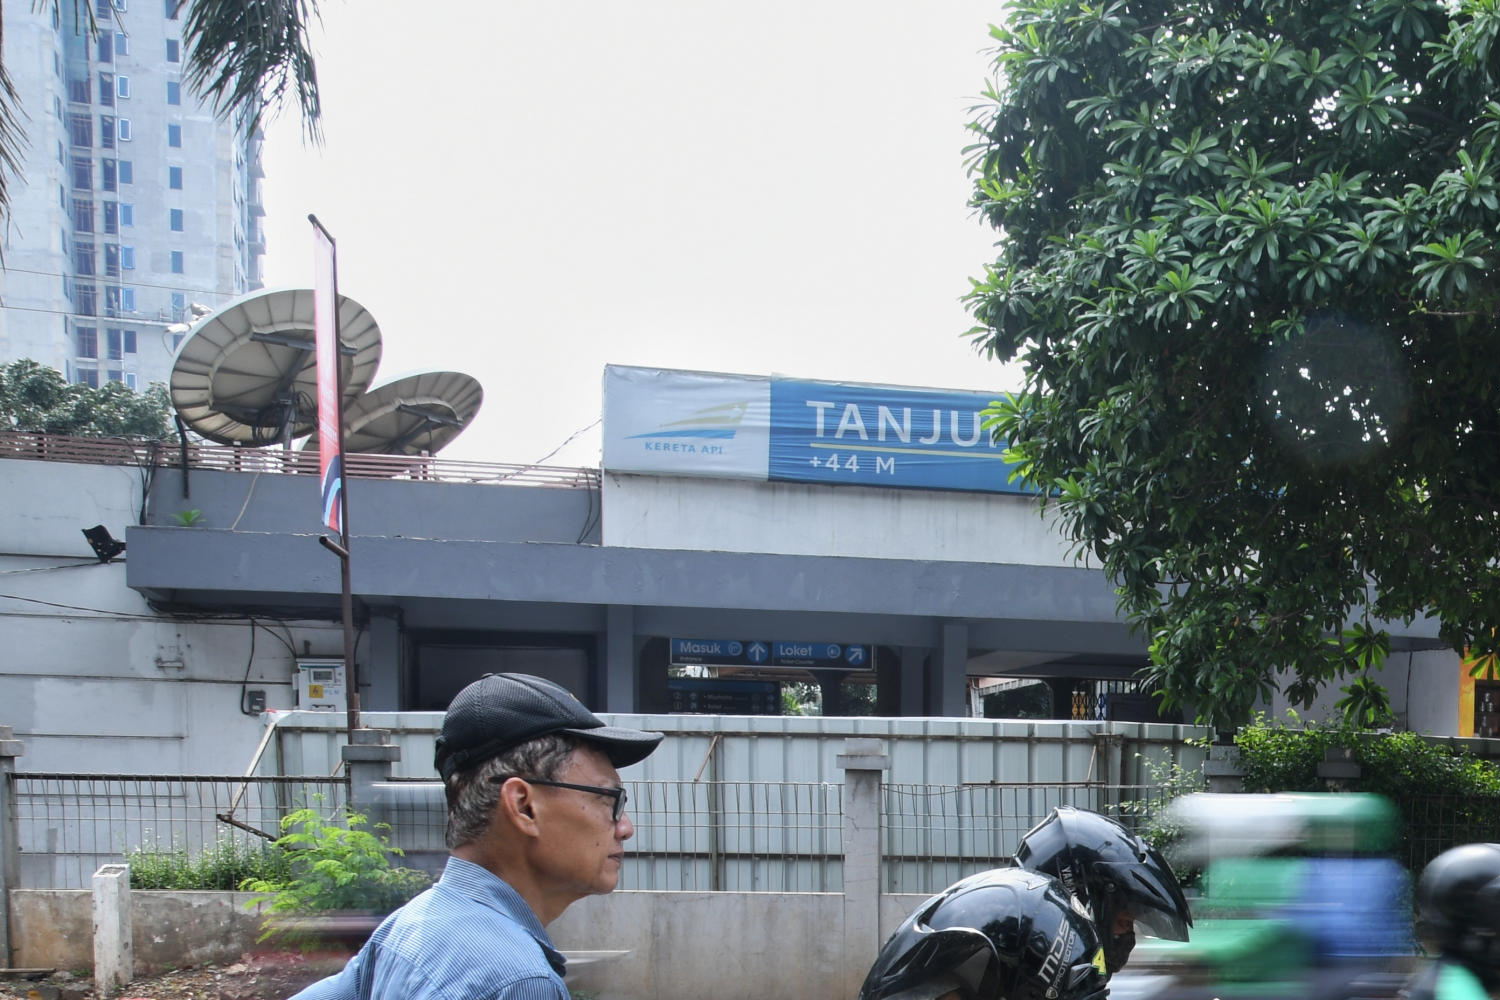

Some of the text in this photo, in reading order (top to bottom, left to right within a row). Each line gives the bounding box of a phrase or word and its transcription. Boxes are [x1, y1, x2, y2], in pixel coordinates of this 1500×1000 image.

[806, 400, 999, 449] TANJU
[644, 441, 724, 455] KERETA API
[809, 454, 895, 475] +44 M
[679, 641, 813, 657] Masuk Loket
[1053, 931, 1077, 990] PROTECTOR
